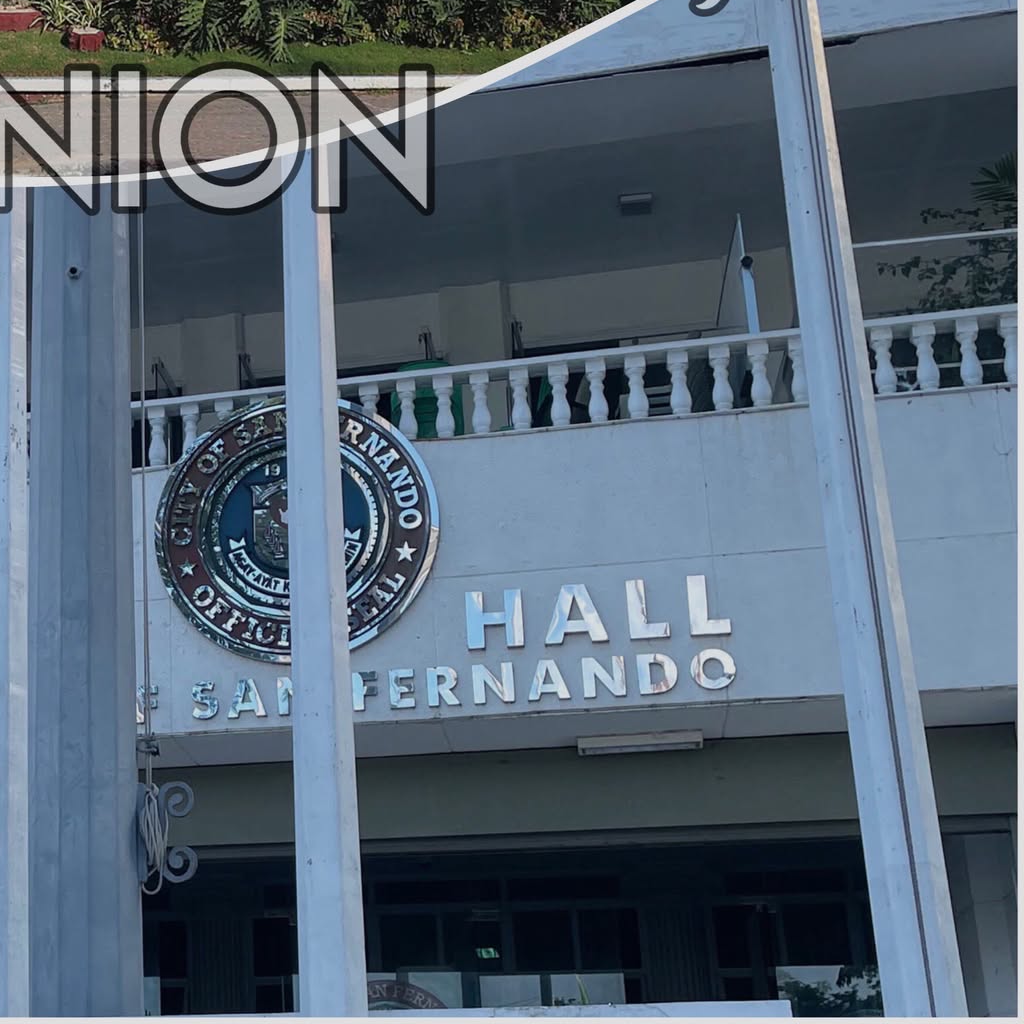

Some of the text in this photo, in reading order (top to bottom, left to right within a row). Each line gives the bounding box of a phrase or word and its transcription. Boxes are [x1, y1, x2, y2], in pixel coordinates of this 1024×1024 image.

[171, 477, 201, 545] CITY
[197, 438, 229, 474] OF
[192, 585, 289, 646] OFFICI
[464, 574, 731, 650] HALL
[353, 648, 737, 712] FERNANDO
